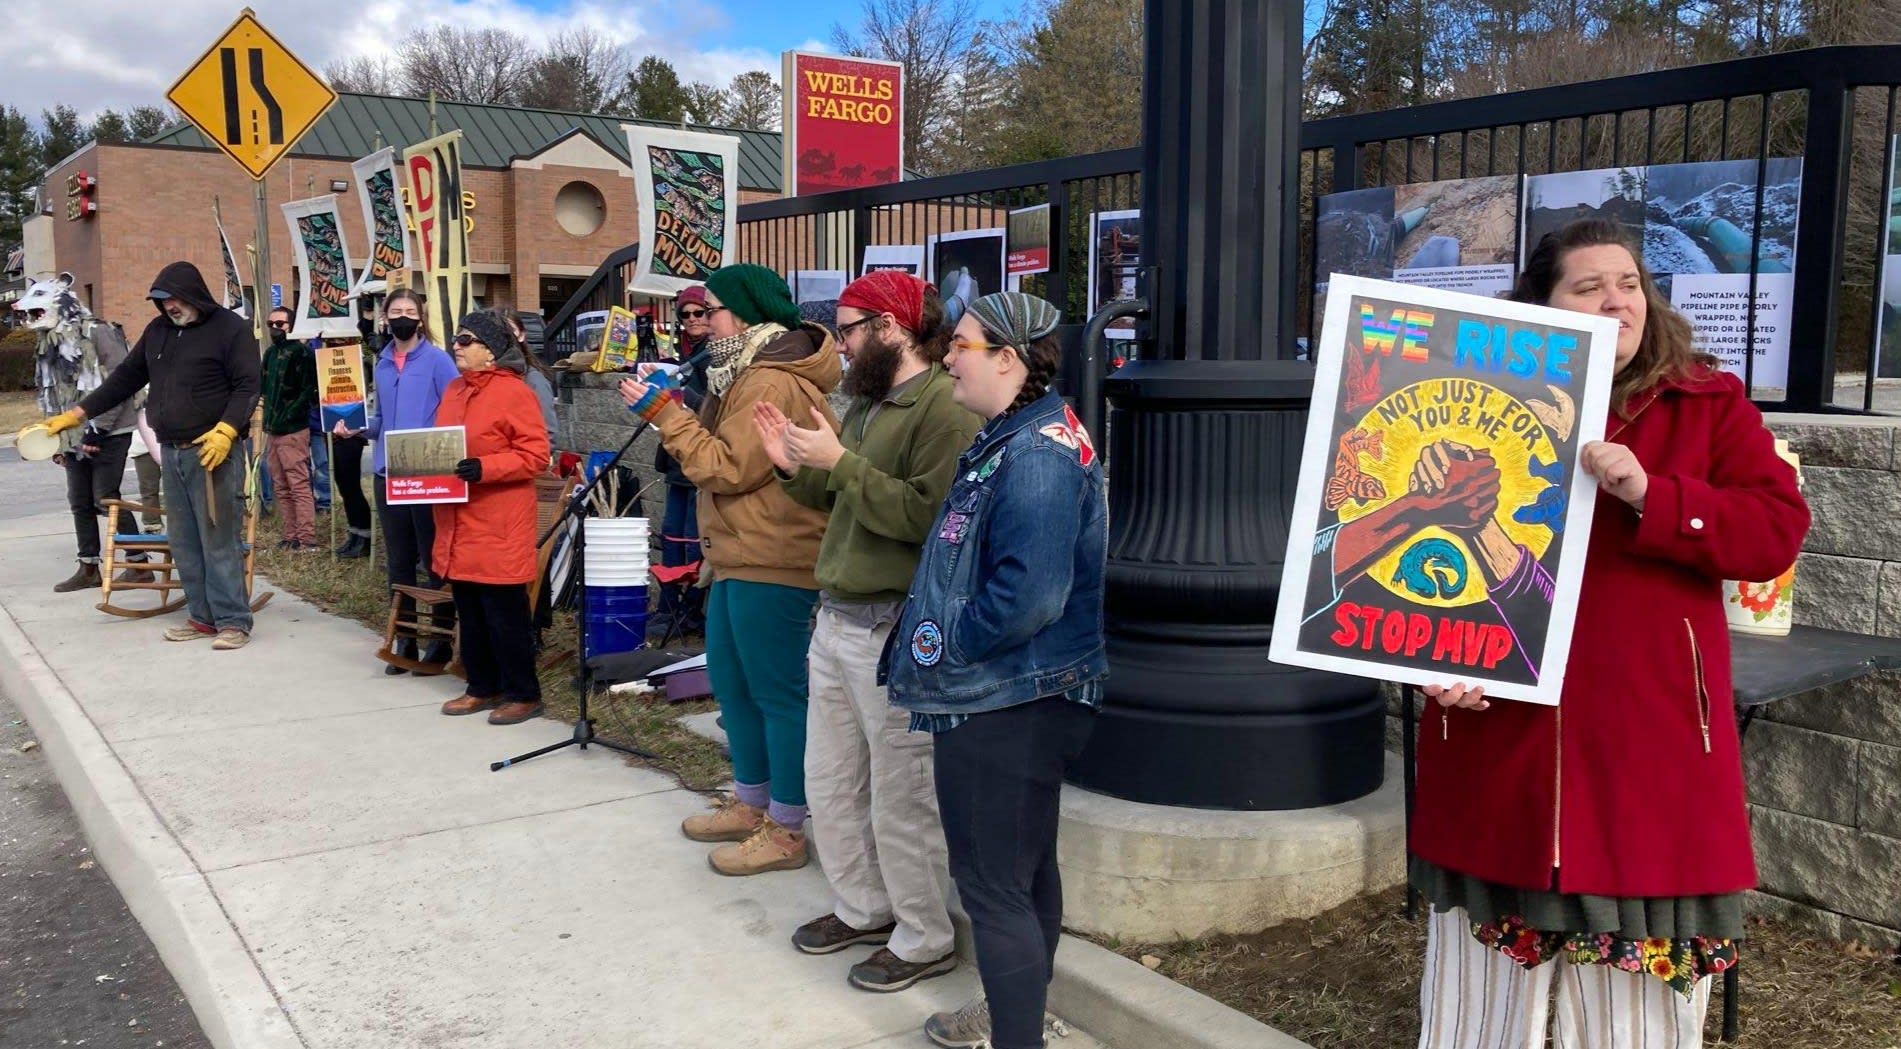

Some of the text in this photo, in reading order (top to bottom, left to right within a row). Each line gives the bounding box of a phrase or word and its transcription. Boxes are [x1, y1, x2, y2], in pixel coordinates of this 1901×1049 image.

[804, 70, 893, 100] WELLS
[807, 95, 892, 124] FARGO
[654, 234, 697, 275] MVP
[657, 210, 721, 269] DEFUND
[1360, 303, 1578, 384] WE RISE
[1735, 325, 1776, 333] LOATED
[1740, 336, 1772, 344] RCKS
[1376, 379, 1544, 451] NOT JUST FOR
[1408, 405, 1507, 440] YOU & ME
[1330, 601, 1513, 669] STOP MVP
